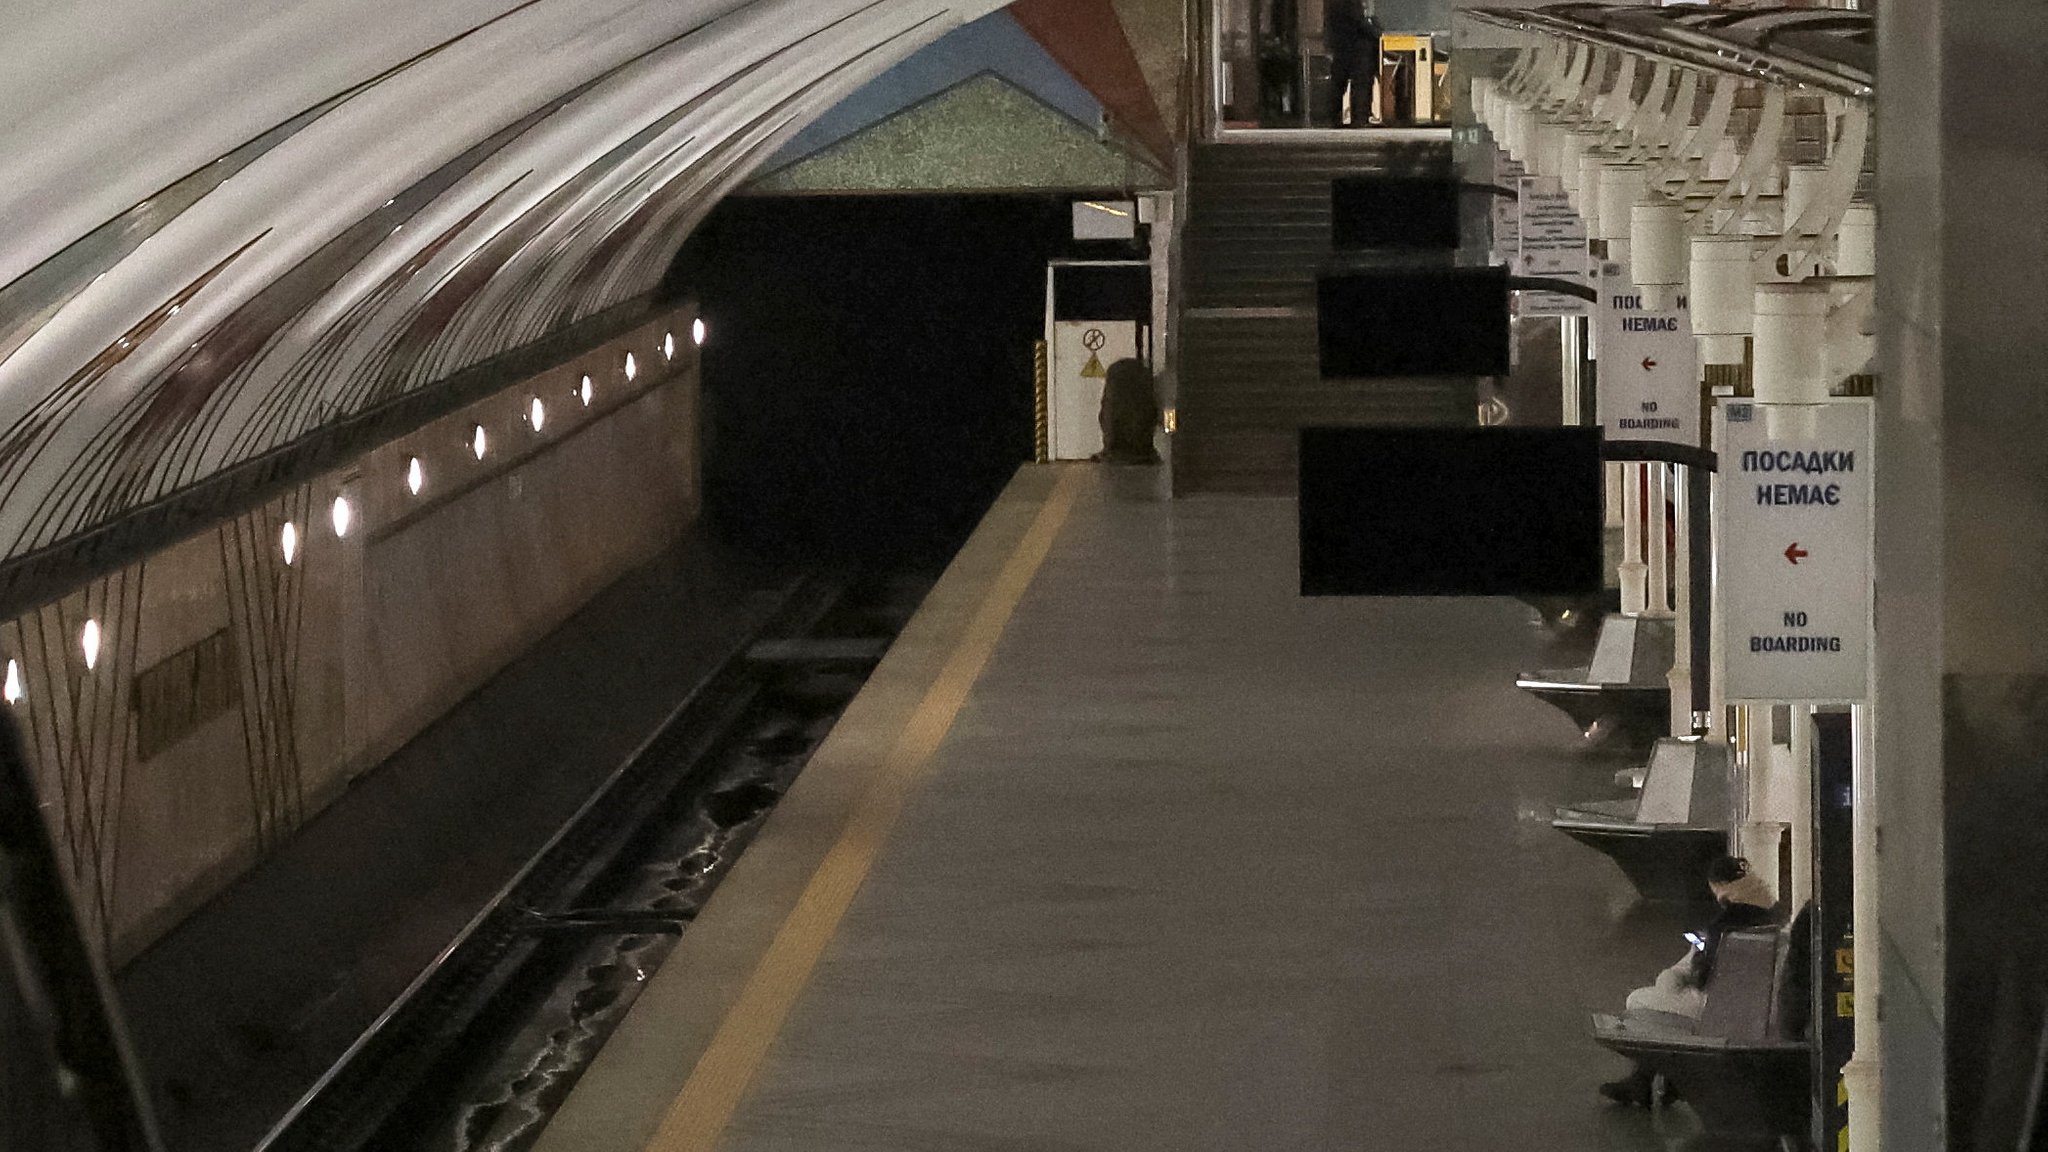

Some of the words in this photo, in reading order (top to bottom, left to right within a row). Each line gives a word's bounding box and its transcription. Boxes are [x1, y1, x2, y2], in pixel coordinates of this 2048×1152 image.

[1613, 295, 1687, 310] ПОСИ
[1622, 317, 1678, 331] НЕМАЄ
[1641, 402, 1657, 412] NO
[1619, 418, 1680, 429] BOARDING
[1742, 450, 1854, 474] ПОСАДКИ
[1757, 484, 1840, 505] НЕМАЄ
[1783, 612, 1808, 627] NO
[1750, 636, 1841, 652] BOARDING
